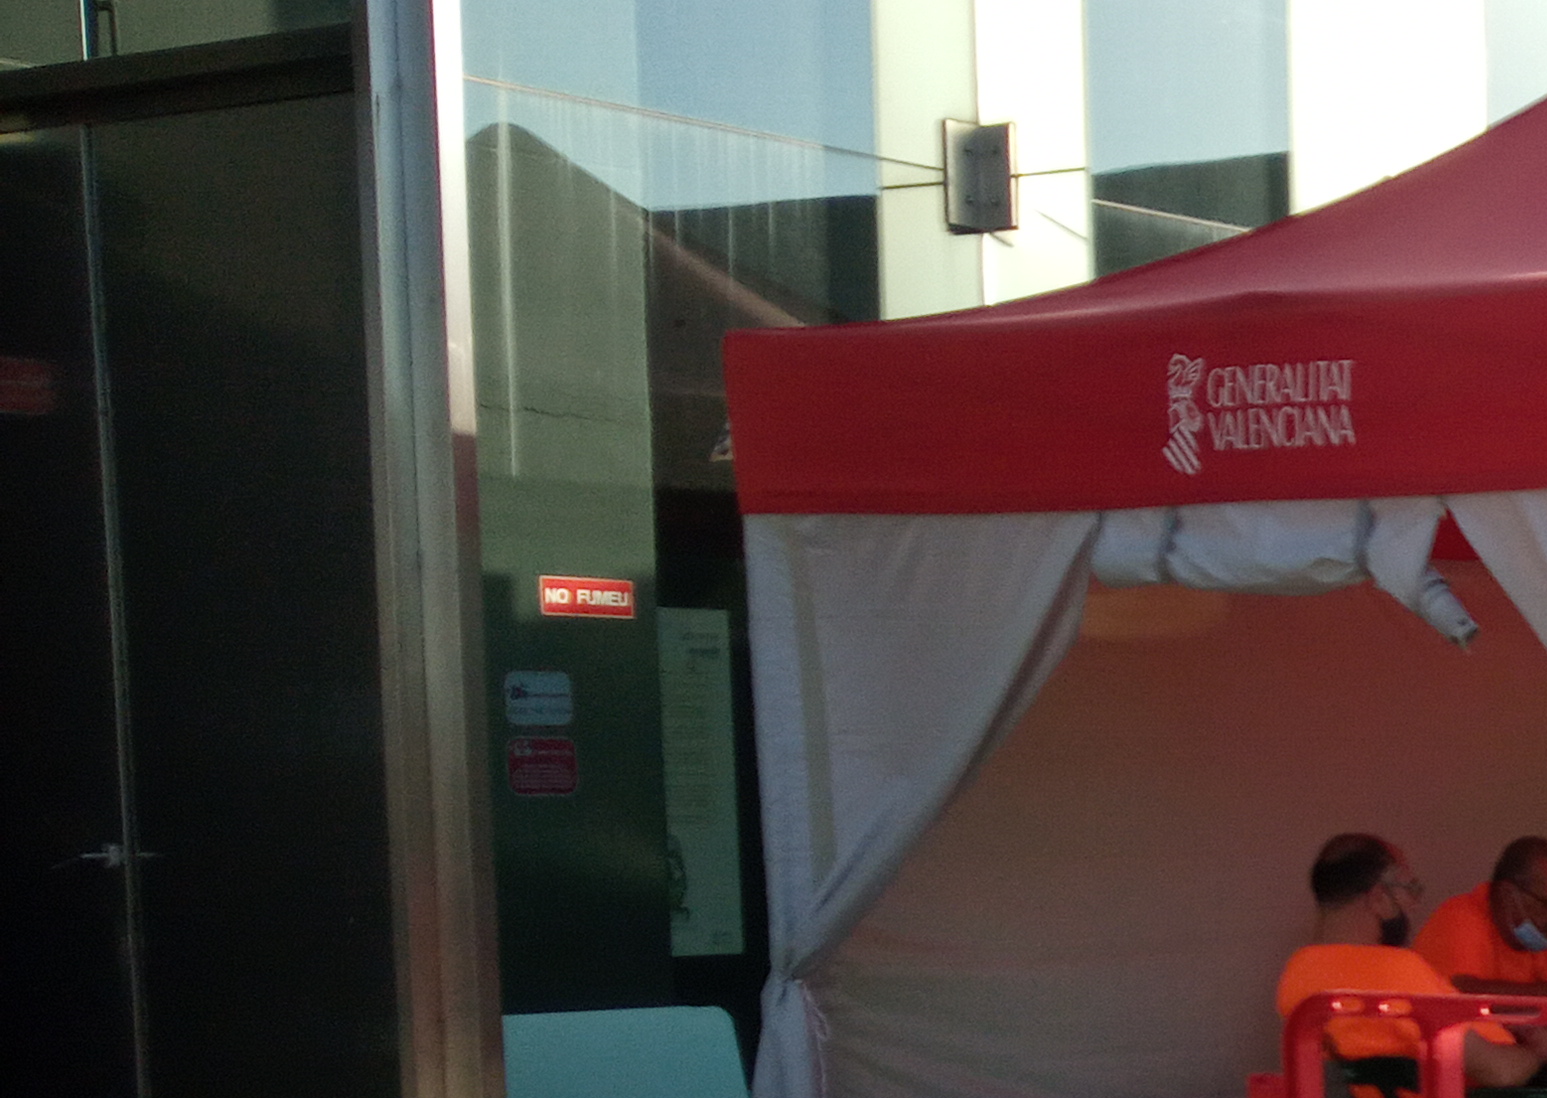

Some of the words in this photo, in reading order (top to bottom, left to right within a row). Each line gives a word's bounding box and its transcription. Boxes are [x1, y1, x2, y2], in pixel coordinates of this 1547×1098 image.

[1207, 359, 1354, 408] GENERALITAT
[1207, 404, 1356, 450] VALENCIANA
[544, 587, 569, 604] NO
[577, 589, 629, 607] FUMEU
